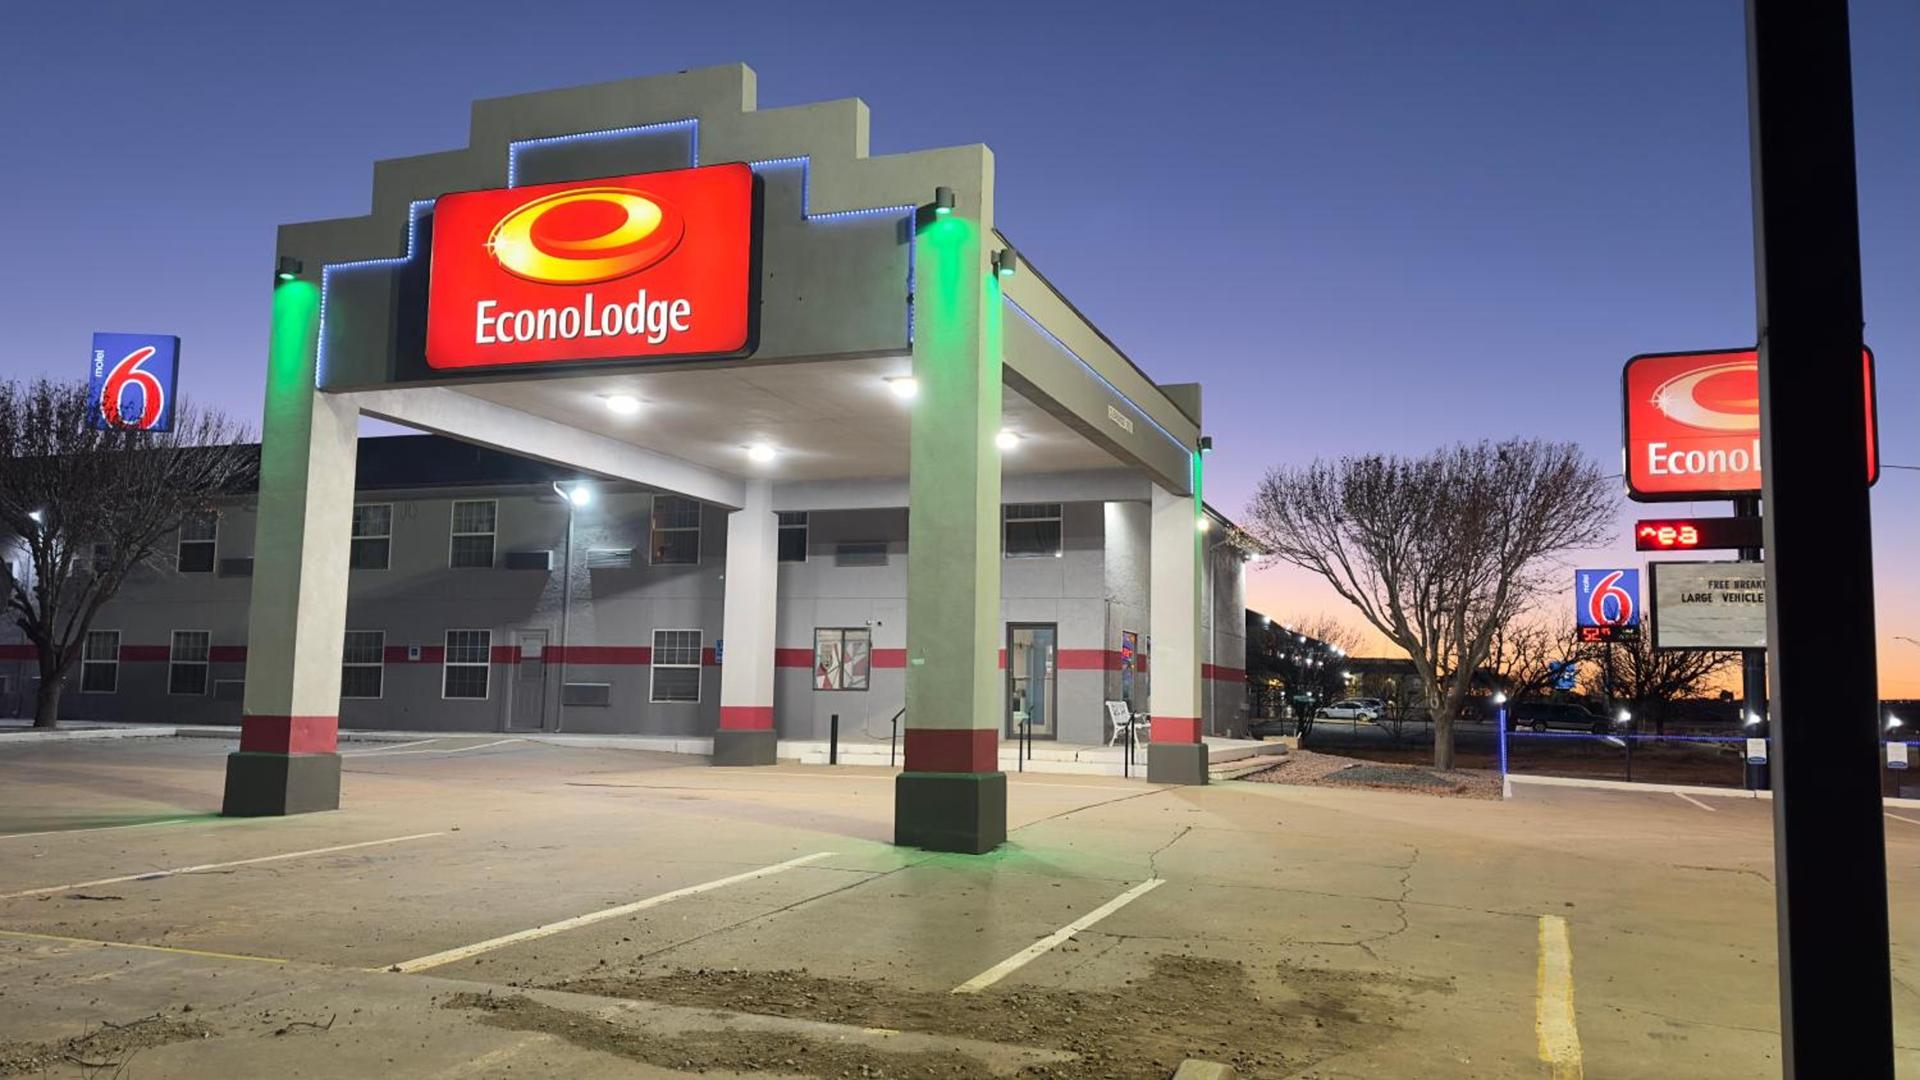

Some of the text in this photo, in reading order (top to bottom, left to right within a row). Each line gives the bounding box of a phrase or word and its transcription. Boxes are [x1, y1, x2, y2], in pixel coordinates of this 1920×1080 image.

[475, 289, 691, 344] EconoLodge
[94, 346, 164, 430] motel 6
[1589, 571, 1633, 626] 6
[1681, 593, 1713, 603] LARGE
[1708, 580, 1730, 590] FREE
